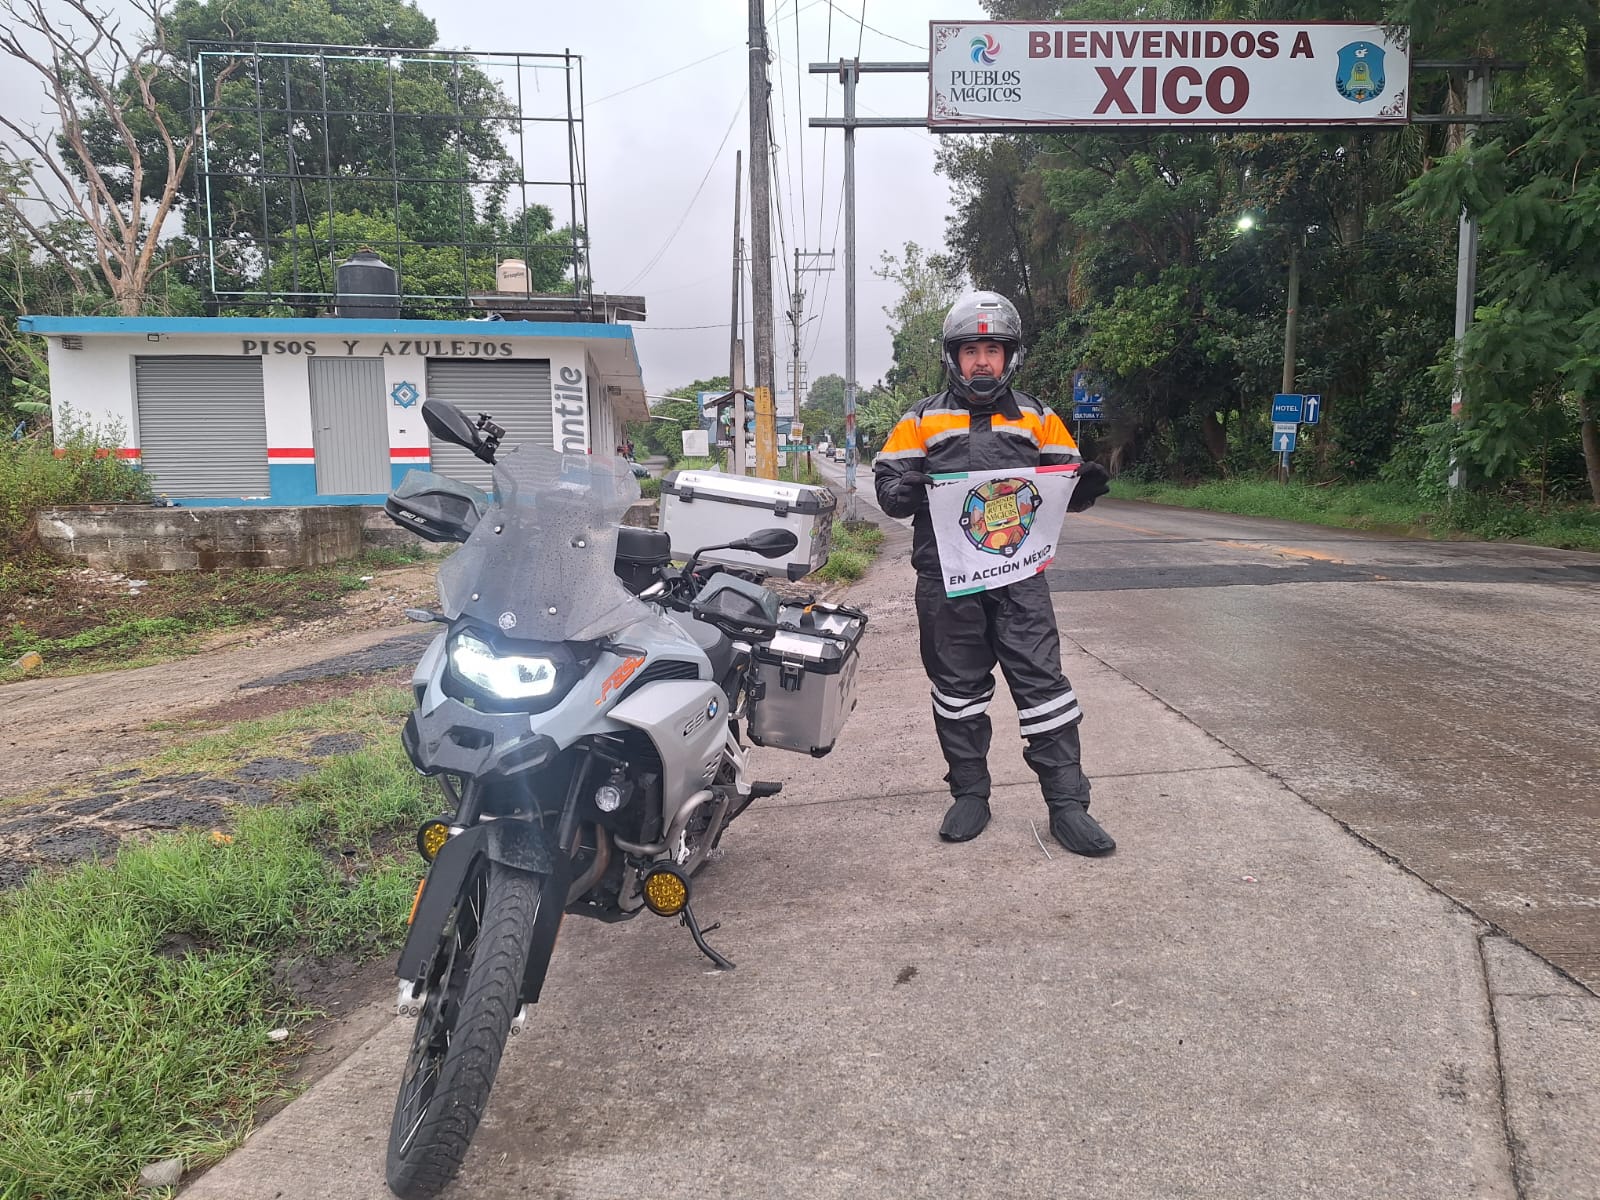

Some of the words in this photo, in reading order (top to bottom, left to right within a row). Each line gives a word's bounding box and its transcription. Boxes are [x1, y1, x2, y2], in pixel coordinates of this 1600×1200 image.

[1028, 30, 1280, 60] BIENVENIDOS
[1289, 31, 1315, 60] A
[950, 70, 1021, 86] PUEBLOS
[1092, 65, 1250, 116] XICO
[242, 340, 317, 355] PISOS
[343, 340, 360, 355] Y
[379, 340, 513, 356] AZULEJOS
[949, 575, 966, 586] EN
[971, 561, 1020, 582] ACCIÓN
